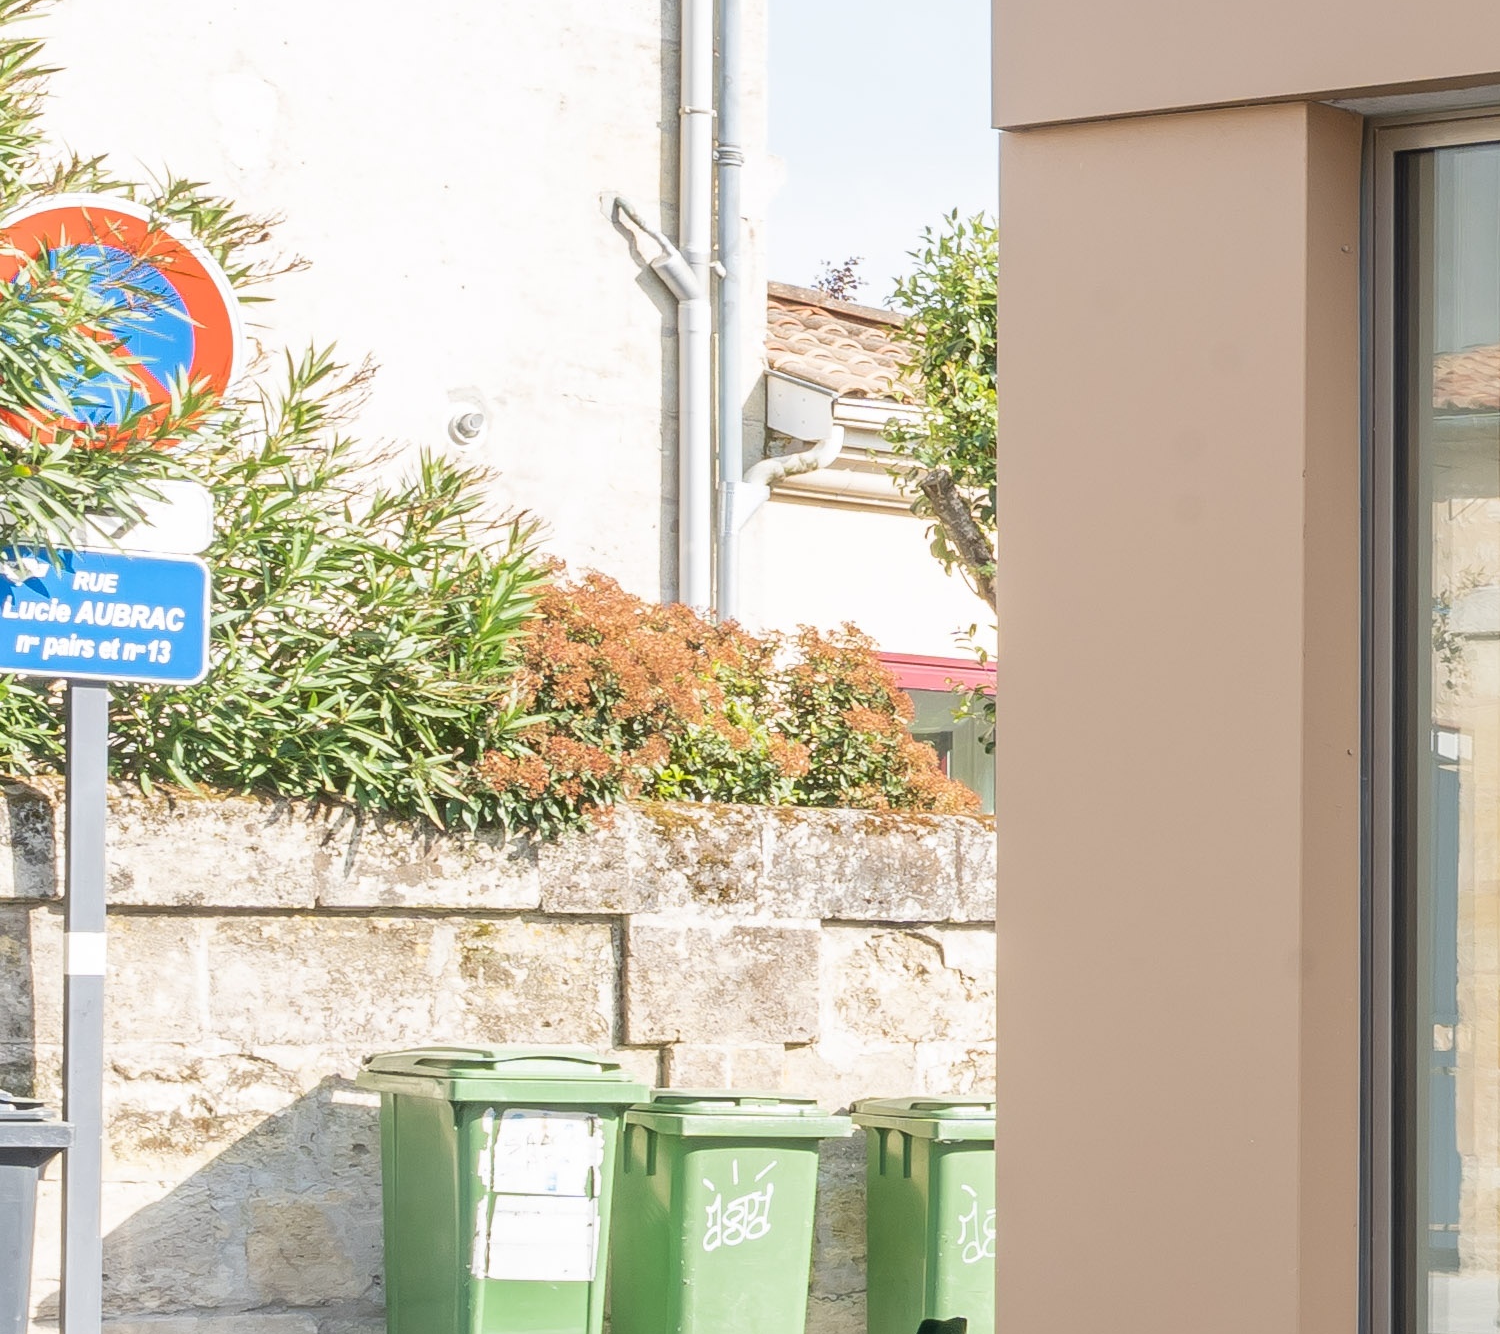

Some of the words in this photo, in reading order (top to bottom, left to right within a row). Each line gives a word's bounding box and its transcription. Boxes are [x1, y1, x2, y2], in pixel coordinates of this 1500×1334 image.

[72, 571, 119, 594] RUE
[3, 596, 71, 623] Lucie
[74, 600, 185, 632] AUBRAC
[42, 633, 95, 661] pairs
[99, 637, 120, 660] et
[148, 639, 172, 664] 13
